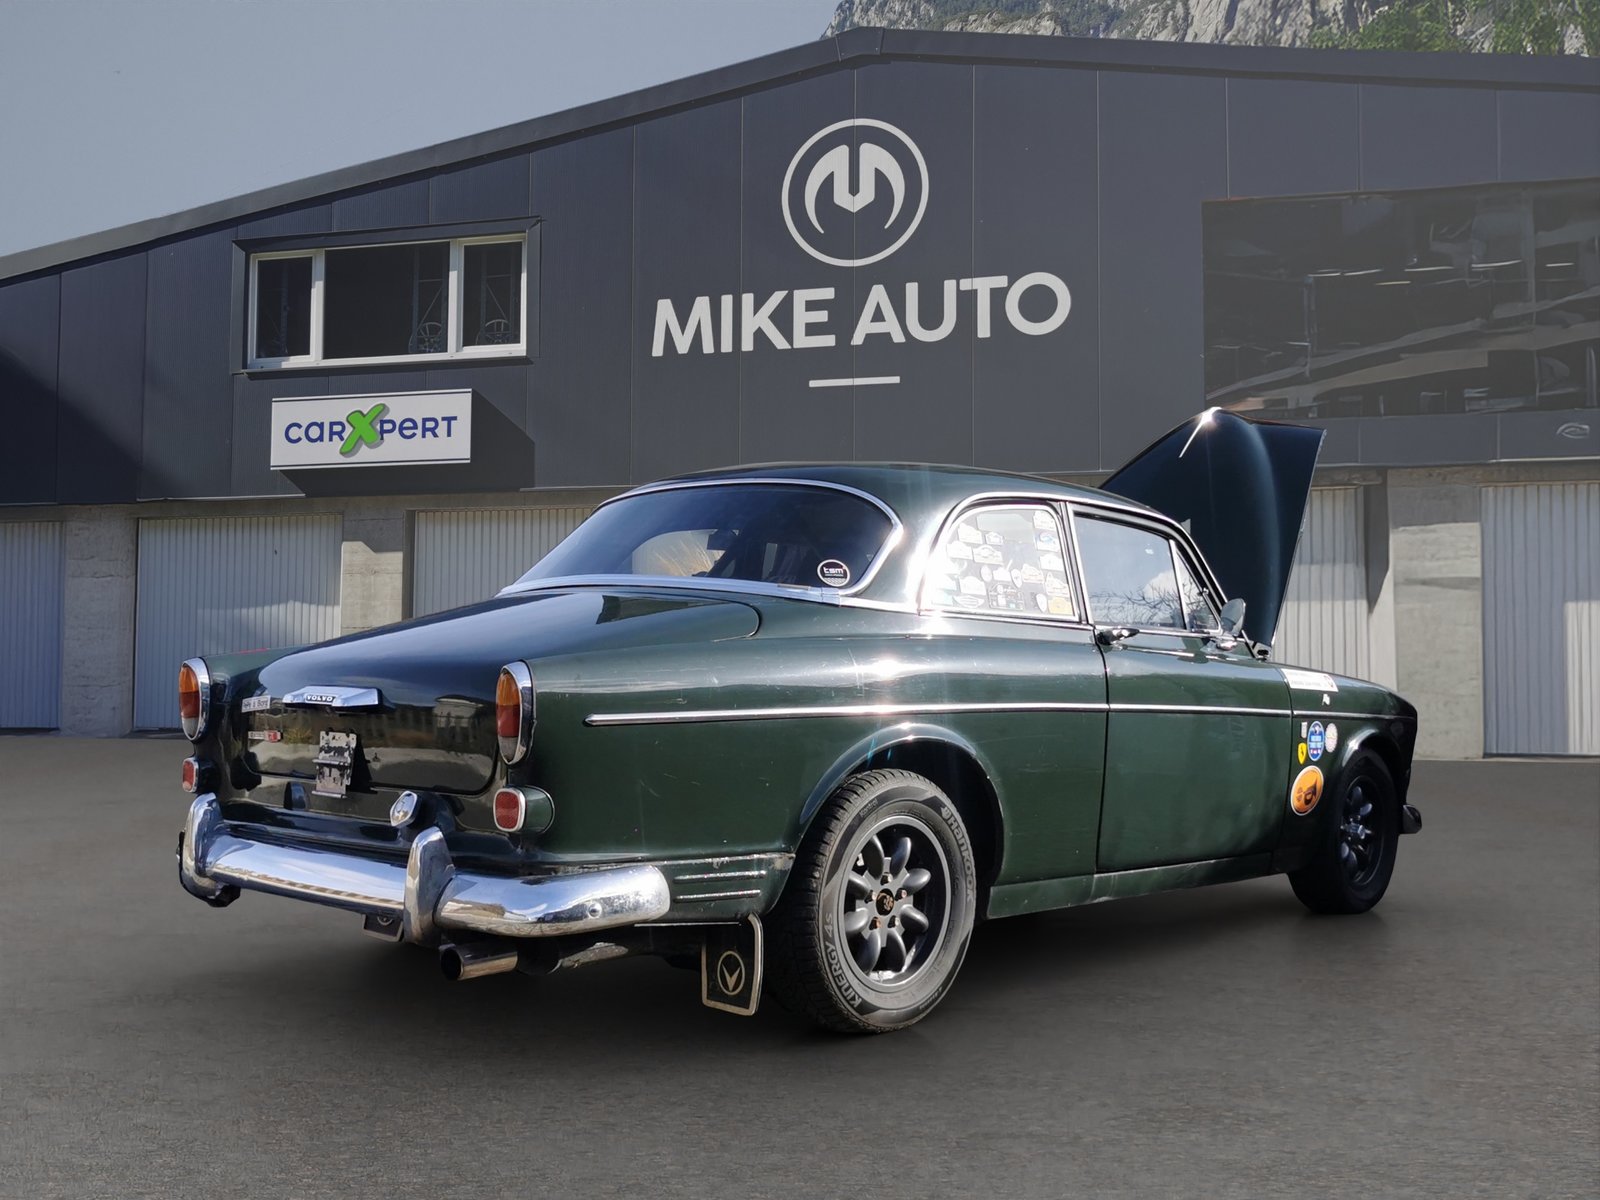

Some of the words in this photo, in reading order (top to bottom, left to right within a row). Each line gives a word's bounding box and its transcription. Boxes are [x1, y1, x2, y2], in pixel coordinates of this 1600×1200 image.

[651, 287, 836, 357] MIKE
[850, 271, 1072, 346] AUTO
[307, 694, 333, 702] VOLVO
